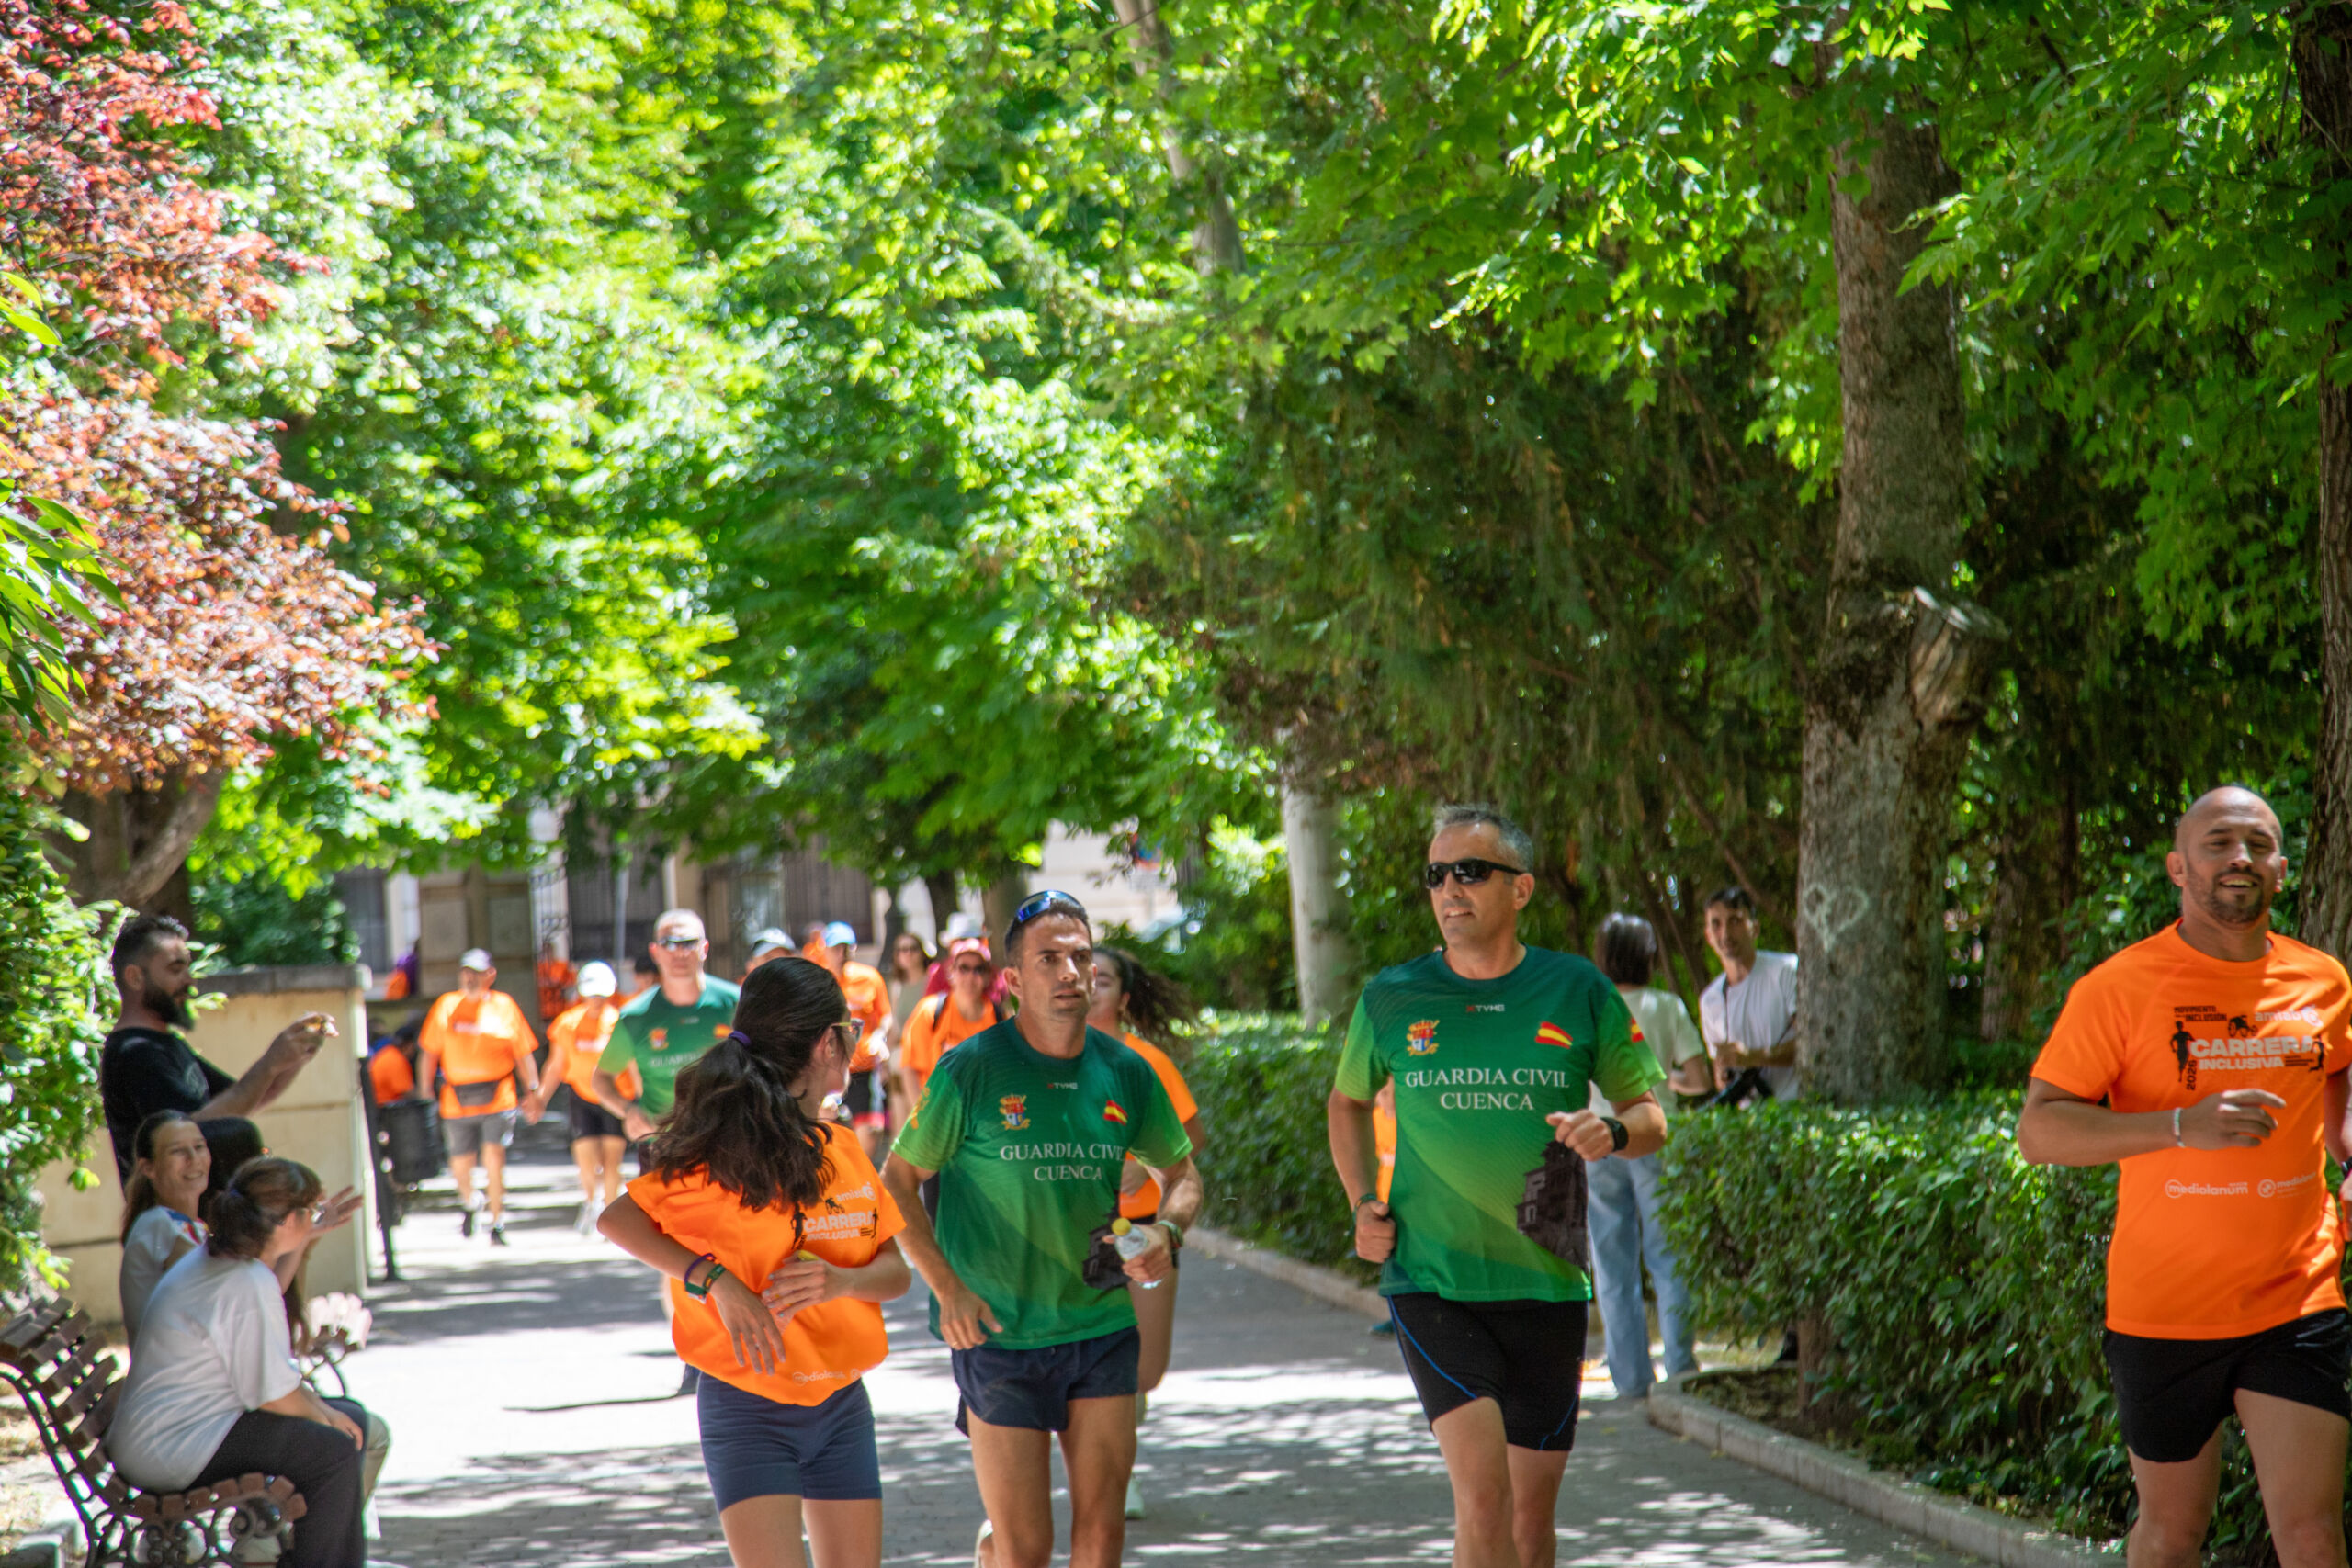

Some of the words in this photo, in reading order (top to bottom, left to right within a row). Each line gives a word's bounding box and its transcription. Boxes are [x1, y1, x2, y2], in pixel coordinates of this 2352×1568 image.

[2190, 1035, 2319, 1058] CARRERA
[2199, 1055, 2285, 1071] INCLUSIVA
[1405, 1067, 1508, 1088] GUARDIA
[1512, 1067, 1570, 1089] CIVIL
[1440, 1092, 1534, 1111] CUENCA
[1000, 1143, 1085, 1161] GUARDIA
[1033, 1164, 1102, 1181] CUENCA
[2165, 1179, 2249, 1199] mediolanum
